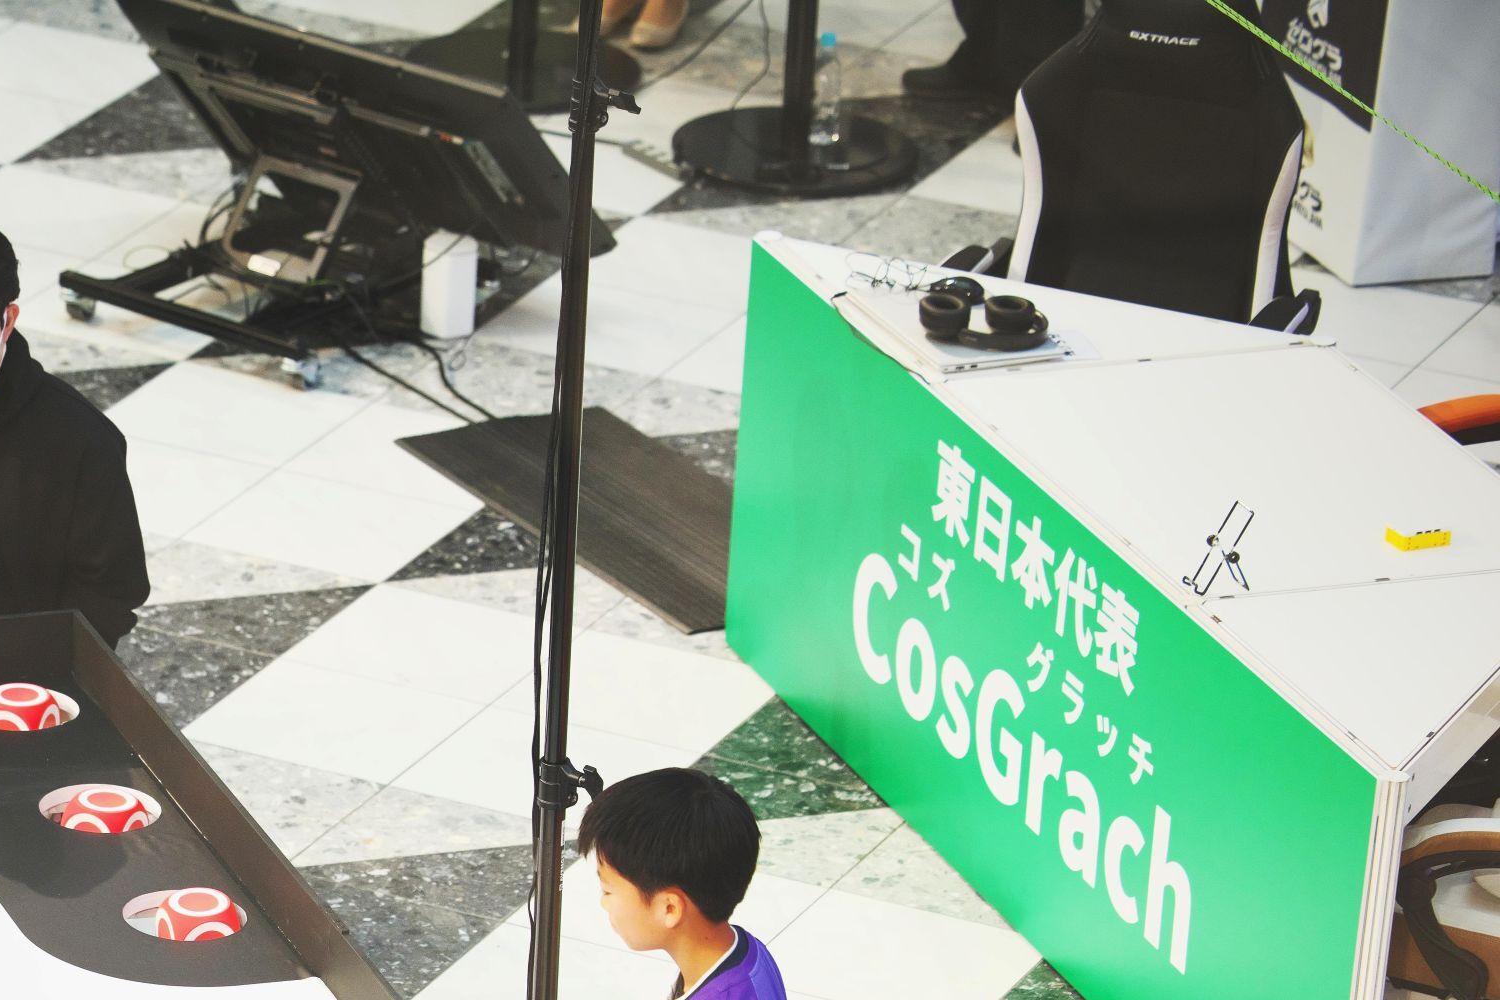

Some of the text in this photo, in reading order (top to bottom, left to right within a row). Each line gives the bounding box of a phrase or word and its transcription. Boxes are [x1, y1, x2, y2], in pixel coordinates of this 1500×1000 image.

[931, 439, 1140, 697] 東日本代表
[852, 552, 1193, 976] CosGrach
[1026, 642, 1154, 785] グラッチ
